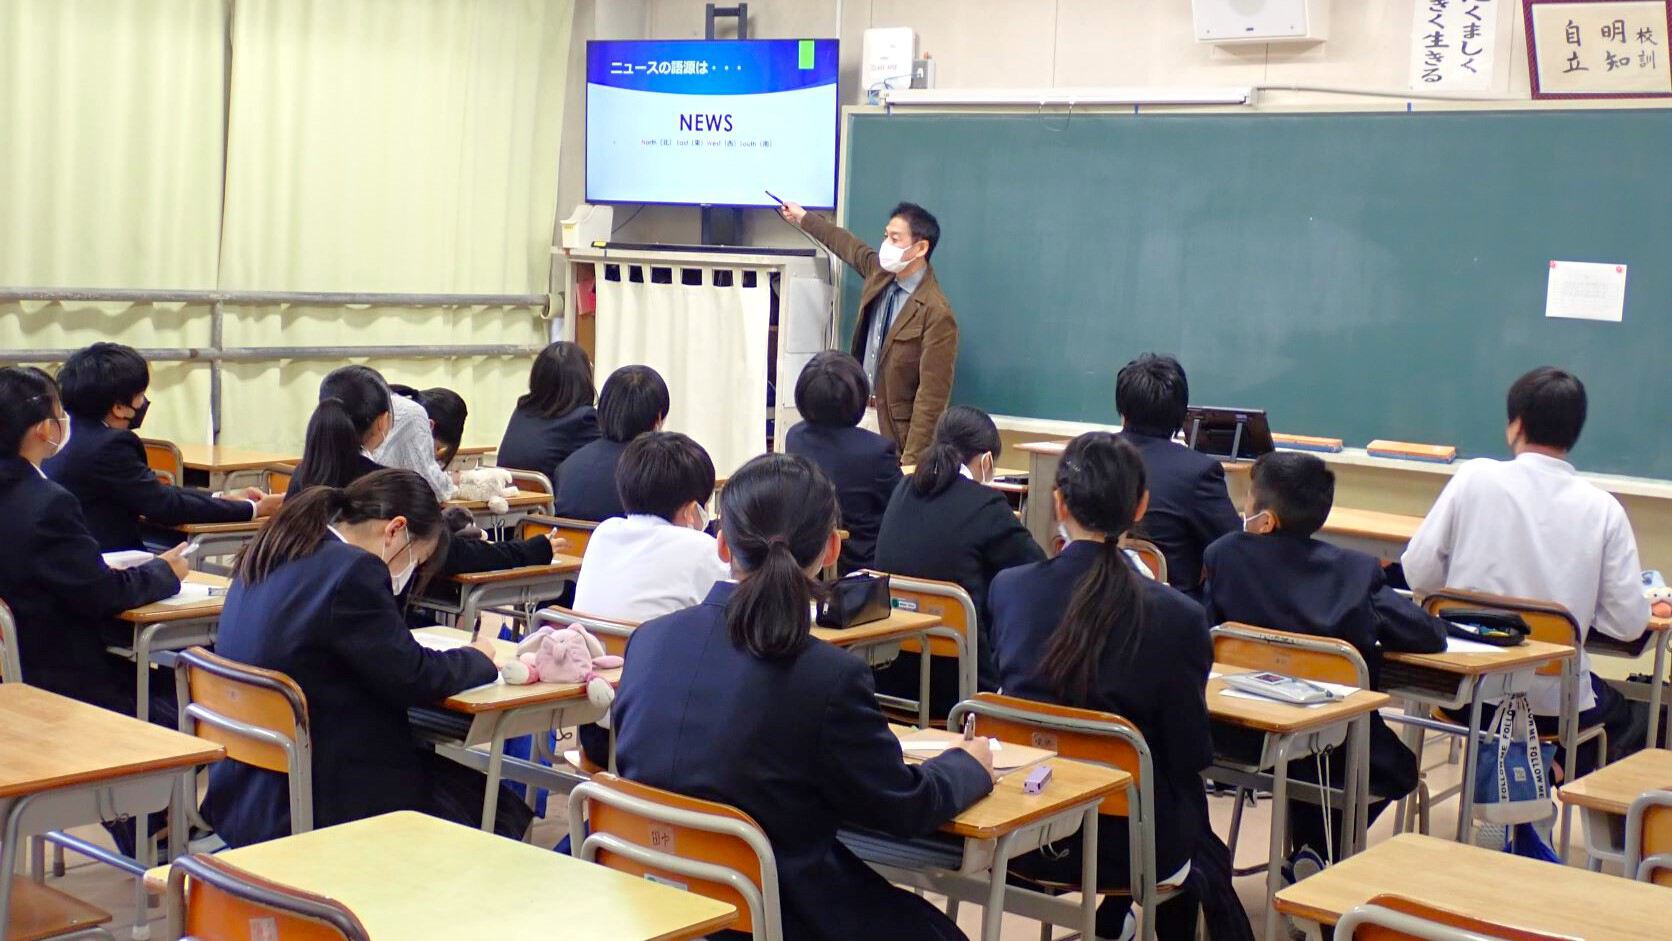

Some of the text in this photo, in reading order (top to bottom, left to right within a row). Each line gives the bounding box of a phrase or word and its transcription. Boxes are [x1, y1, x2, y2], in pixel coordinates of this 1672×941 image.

[1460, 0, 1489, 73] くましく
[1562, 19, 1590, 74] 自立
[1600, 19, 1631, 72] 明知
[1637, 26, 1658, 69] 校訓
[680, 113, 733, 132] NEWS
[1529, 745, 1543, 783] FOLLOW
